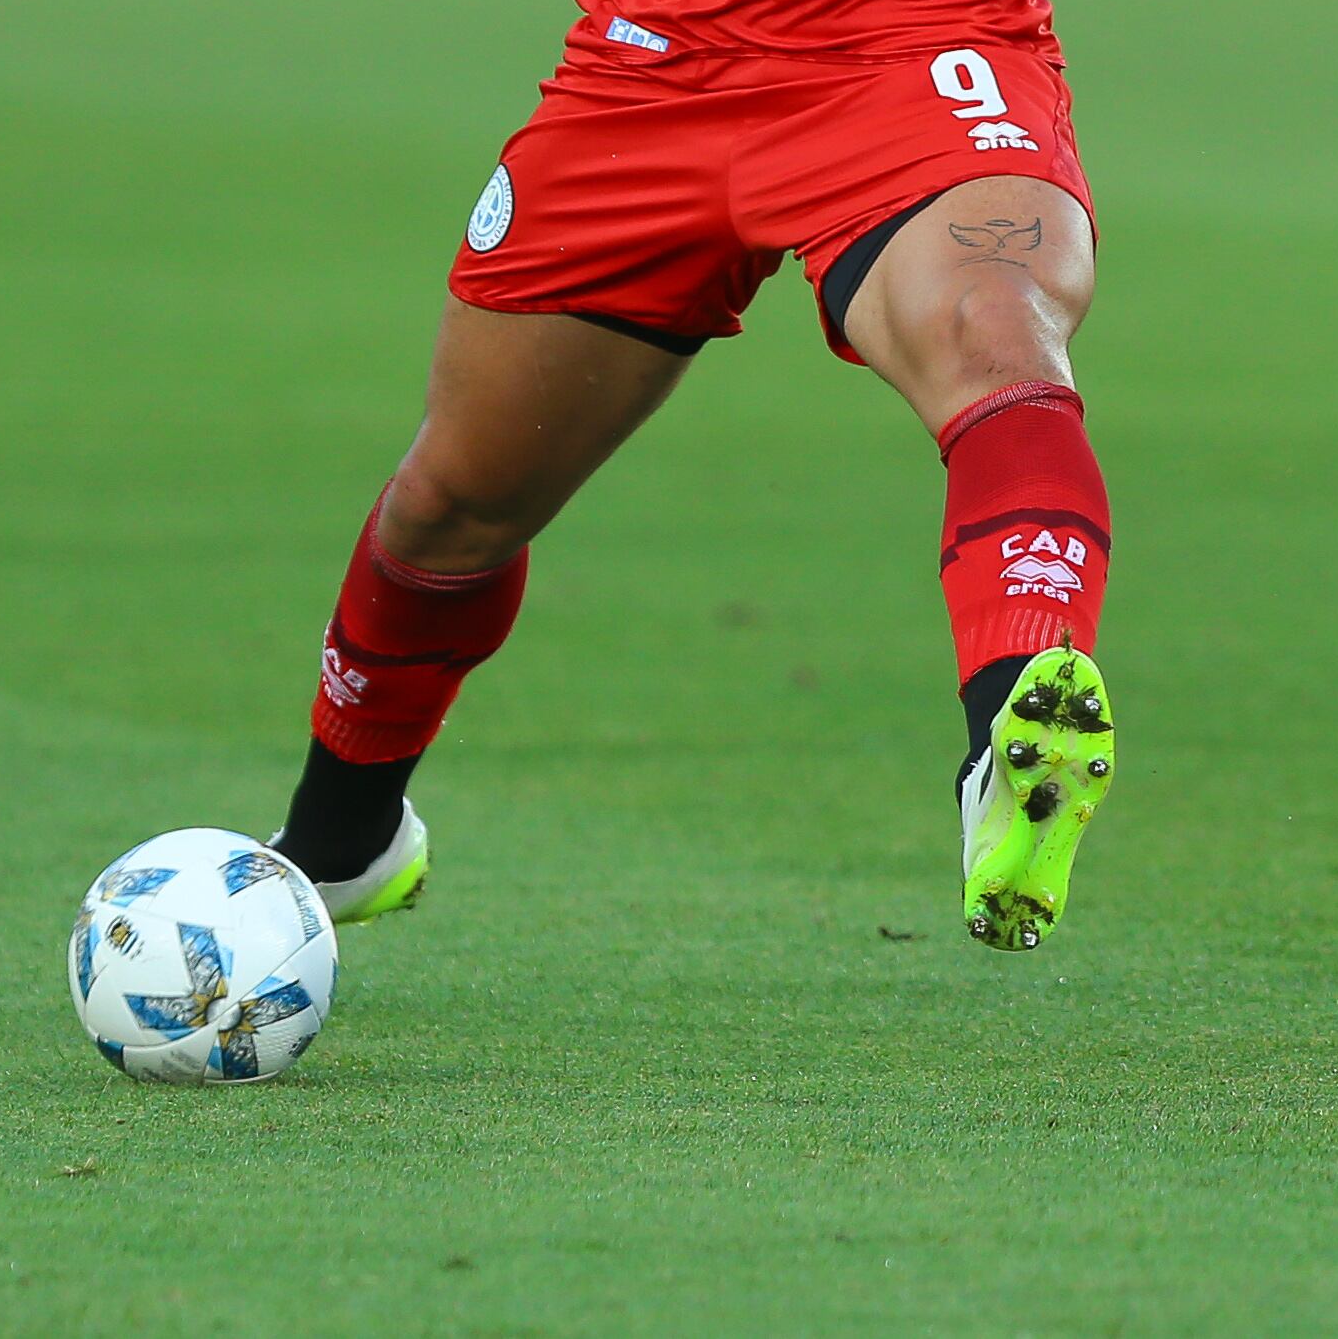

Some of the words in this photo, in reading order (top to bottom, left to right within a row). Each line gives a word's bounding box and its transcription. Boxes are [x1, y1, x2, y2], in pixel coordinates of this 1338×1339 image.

[929, 48, 1009, 119] 9
[974, 137, 1040, 152] errea
[1001, 529, 1087, 567] CAB
[1005, 582, 1070, 604] errea
